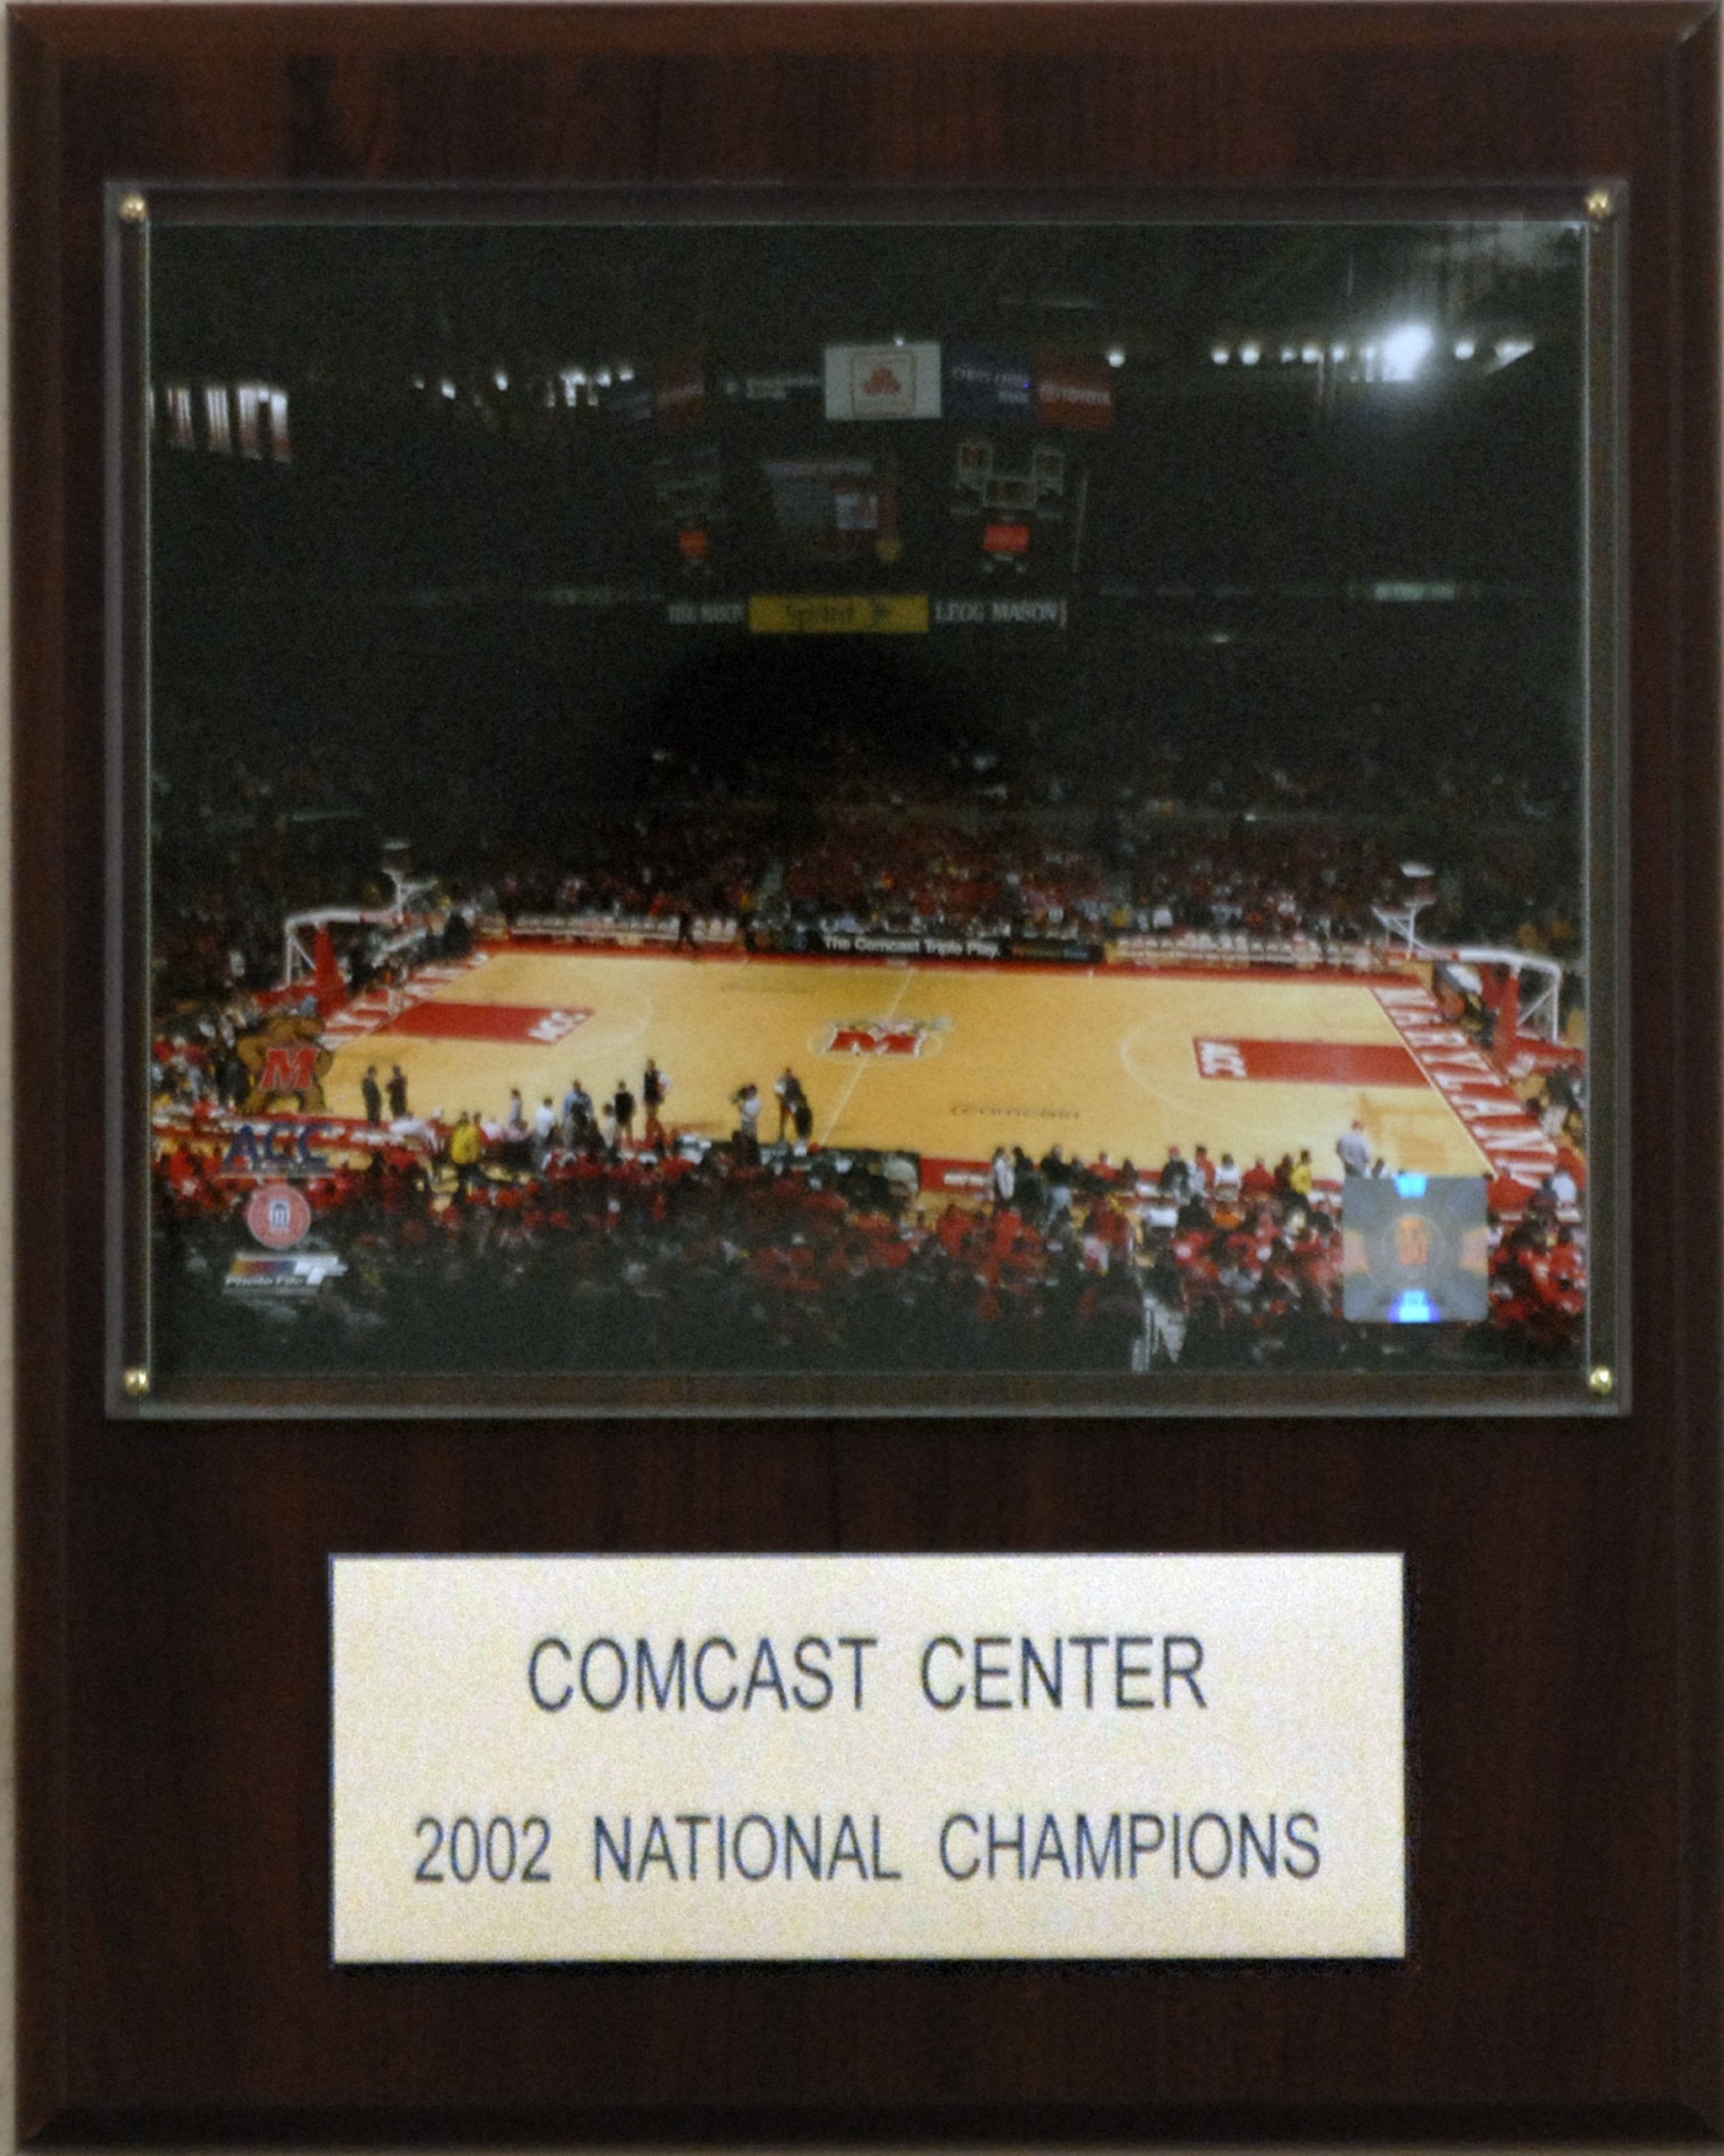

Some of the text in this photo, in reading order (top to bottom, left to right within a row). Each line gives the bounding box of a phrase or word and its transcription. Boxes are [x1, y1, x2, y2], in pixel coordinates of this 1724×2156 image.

[823, 935, 851, 951] The
[854, 937, 920, 953] Comcast
[222, 1123, 334, 1172] ACC
[224, 1274, 274, 1288] Photo
[528, 1635, 1206, 1711] COMCAST CENTER
[414, 1812, 1320, 1882] 2002 NATIONAL CHAMPIONS
